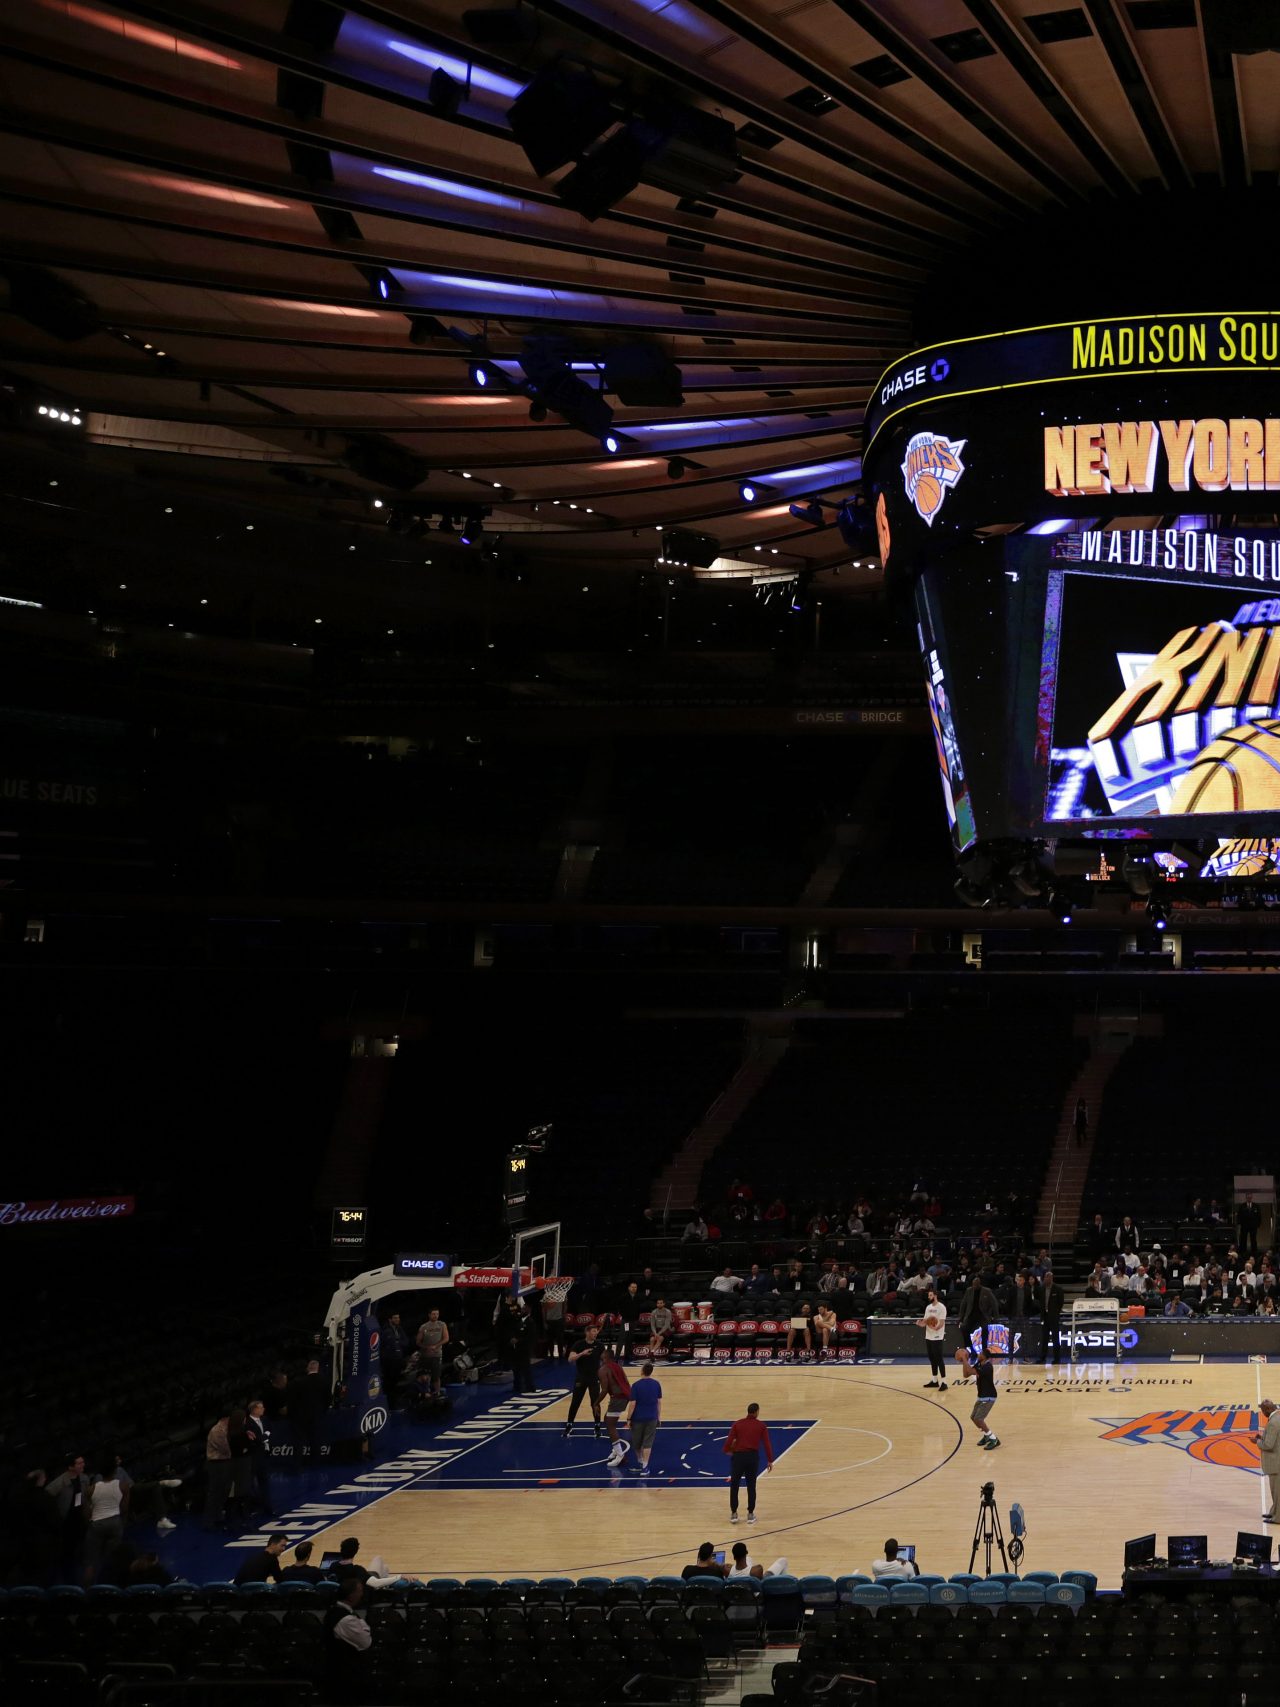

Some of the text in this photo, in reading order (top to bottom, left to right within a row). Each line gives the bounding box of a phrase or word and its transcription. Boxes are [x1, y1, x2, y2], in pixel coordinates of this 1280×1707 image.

[1072, 323, 1207, 370] MADISON
[881, 366, 927, 405] CHASE
[1044, 421, 1159, 497] NEW
[1081, 530, 1218, 574] MADISON
[796, 711, 903, 722] CHASE BRIDGE
[37, 781, 97, 806] SEATS
[0, 1201, 127, 1225] Budweiser
[402, 1260, 434, 1268] CHASE
[1048, 1331, 1116, 1346] HASE
[352, 1327, 360, 1376] SQUARESPACE
[952, 1378, 1193, 1386] MAISON SQUARE GARDEN
[433, 1388, 571, 1440] KNICKS
[1199, 1404, 1251, 1412] NEW
[364, 1411, 383, 1432] KIA
[324, 1448, 464, 1496] YORK
